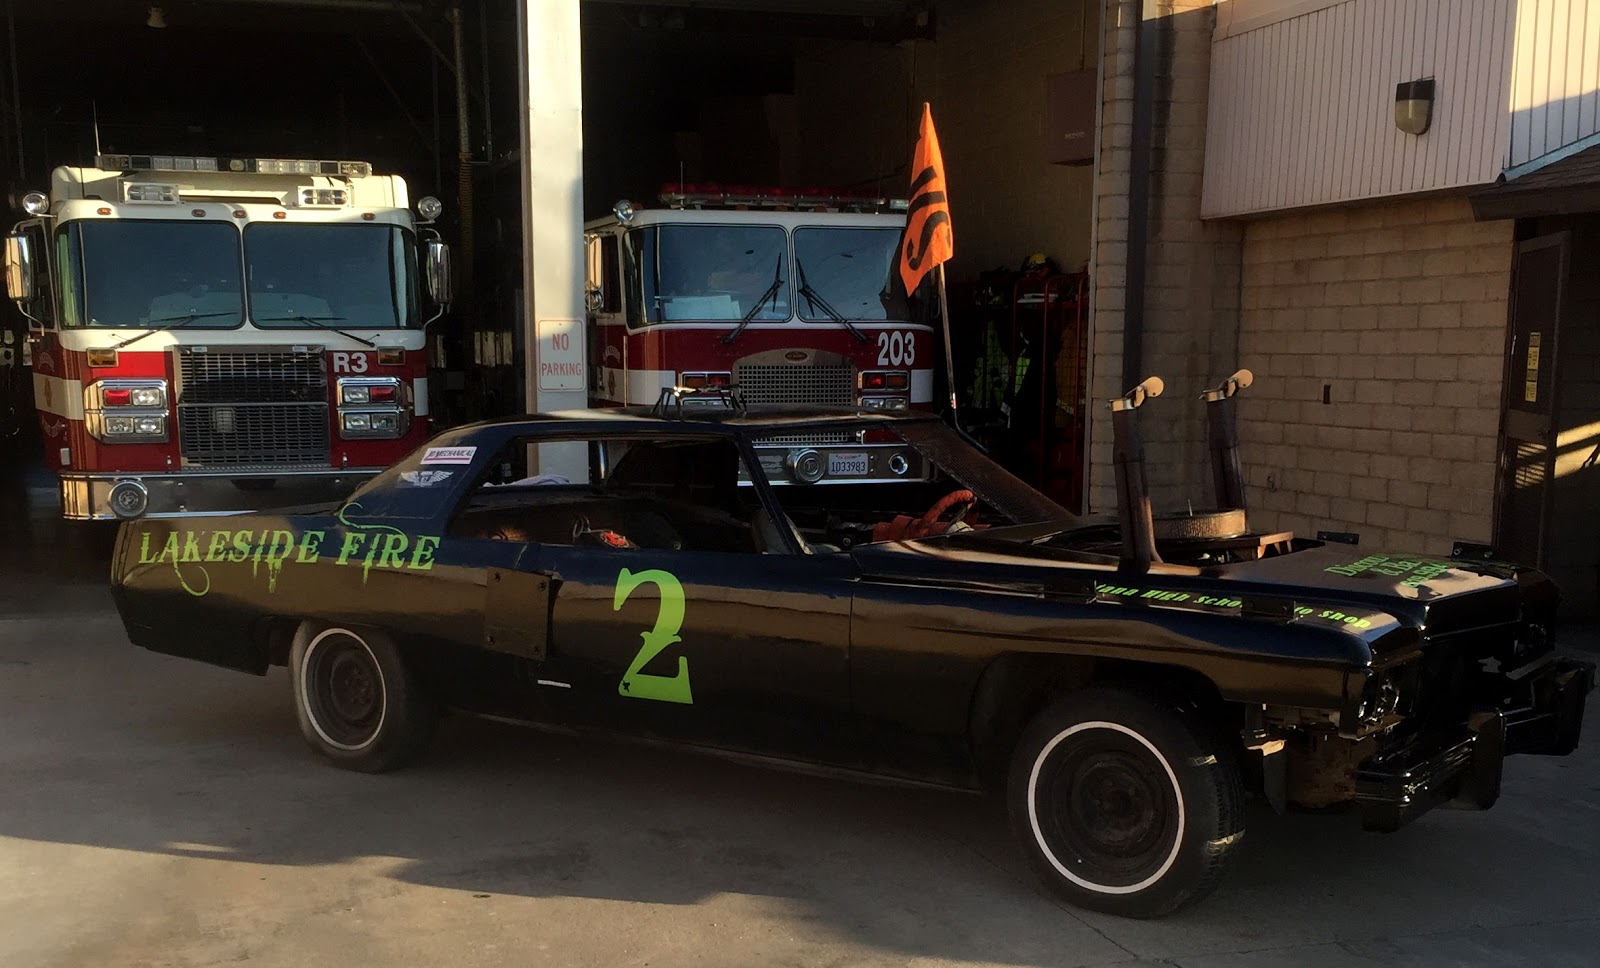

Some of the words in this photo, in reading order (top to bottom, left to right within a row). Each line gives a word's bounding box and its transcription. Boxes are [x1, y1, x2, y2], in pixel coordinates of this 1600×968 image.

[552, 333, 569, 351] NO
[877, 331, 916, 366] 203
[333, 352, 369, 374] R3
[541, 362, 582, 376] PARKING
[436, 450, 474, 458] MECHANICAL
[831, 461, 866, 473] 1033983
[139, 530, 327, 596] LAKESIDE
[336, 502, 442, 585] FIRE
[613, 567, 695, 705] 2
